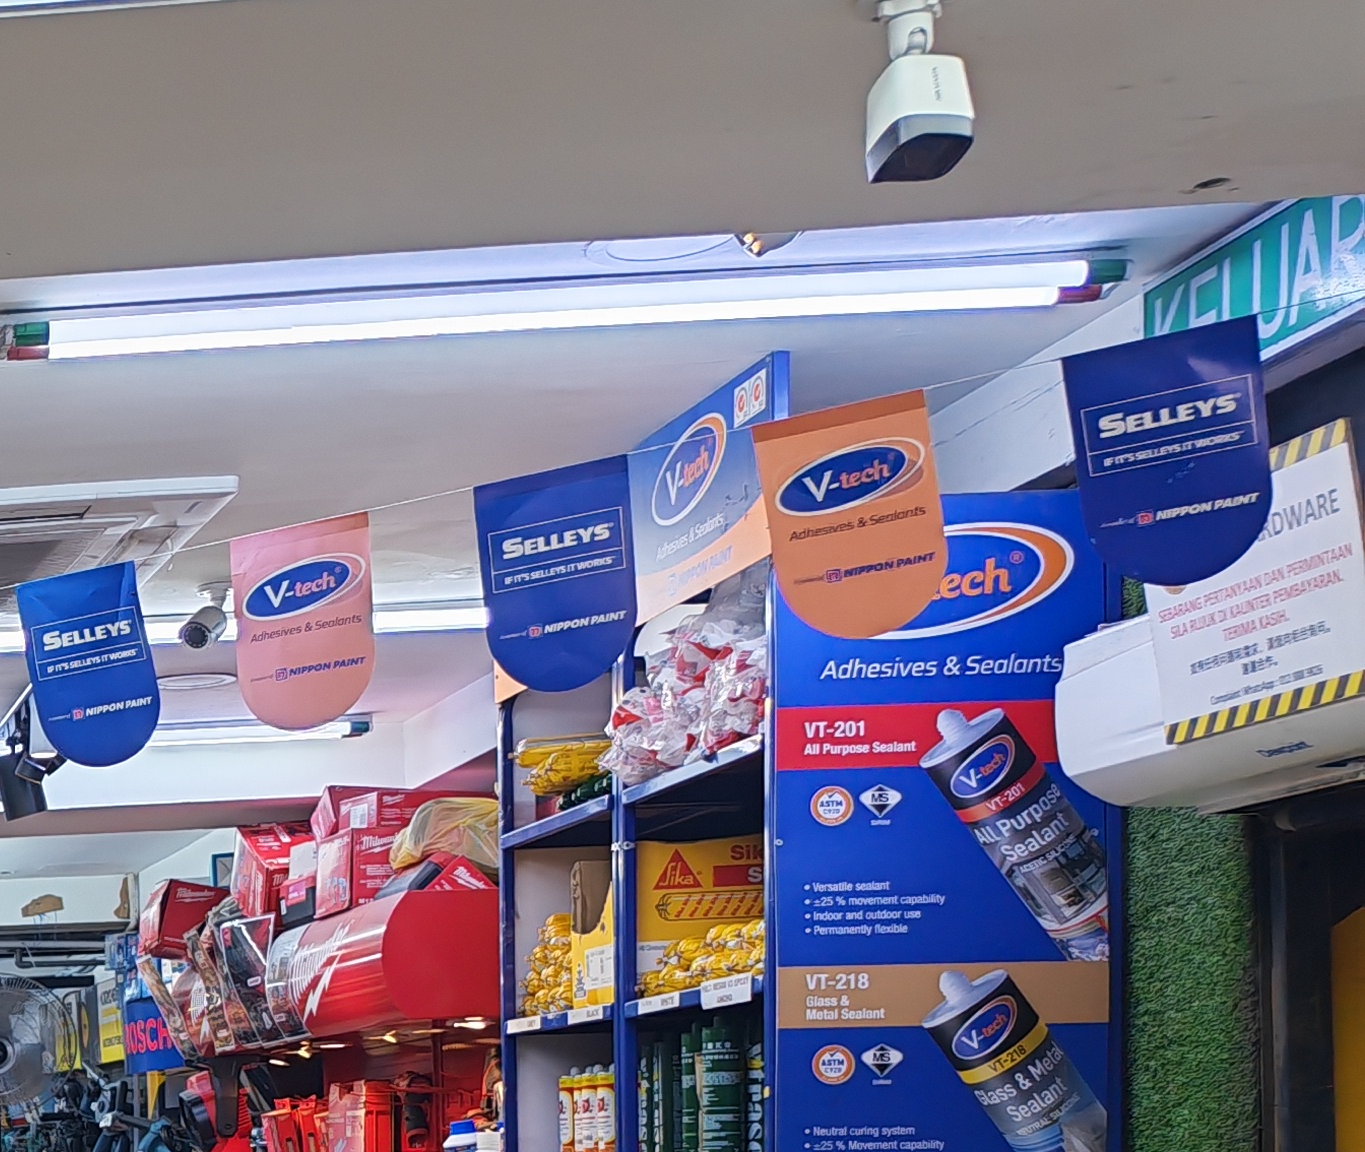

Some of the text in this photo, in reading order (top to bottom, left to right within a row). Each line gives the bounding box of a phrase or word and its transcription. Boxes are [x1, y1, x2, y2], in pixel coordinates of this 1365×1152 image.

[1098, 393, 1237, 439] SELLEYS
[802, 459, 890, 502] V-tech
[1156, 492, 1260, 522] NIPPON PAINT
[502, 523, 611, 560] SELLEYS
[264, 571, 336, 609] V-tech
[43, 620, 130, 651] SELLEYS
[250, 625, 302, 643] Adhesives
[315, 613, 363, 631] Sealants
[544, 610, 627, 635] NIPPON PAINT
[820, 652, 1063, 680] Adhesives & Sealants
[86, 696, 152, 717] NIPPON PAINT
[804, 721, 865, 738] VT-201
[804, 741, 917, 756] All Purpose Sealant
[986, 782, 1027, 811] VT-201
[974, 783, 1061, 845] All Purpose
[1000, 812, 1070, 861] Sealant
[659, 861, 694, 886] Sika
[813, 923, 908, 936] Permanently flexible
[805, 973, 869, 990] VT-218
[805, 995, 850, 1007] Glass &
[805, 1007, 885, 1020] Metal Sealant
[987, 1044, 1028, 1073] VT-218
[1006, 1076, 1068, 1122] Sealant
[813, 1126, 915, 1138] Neutral curing system
